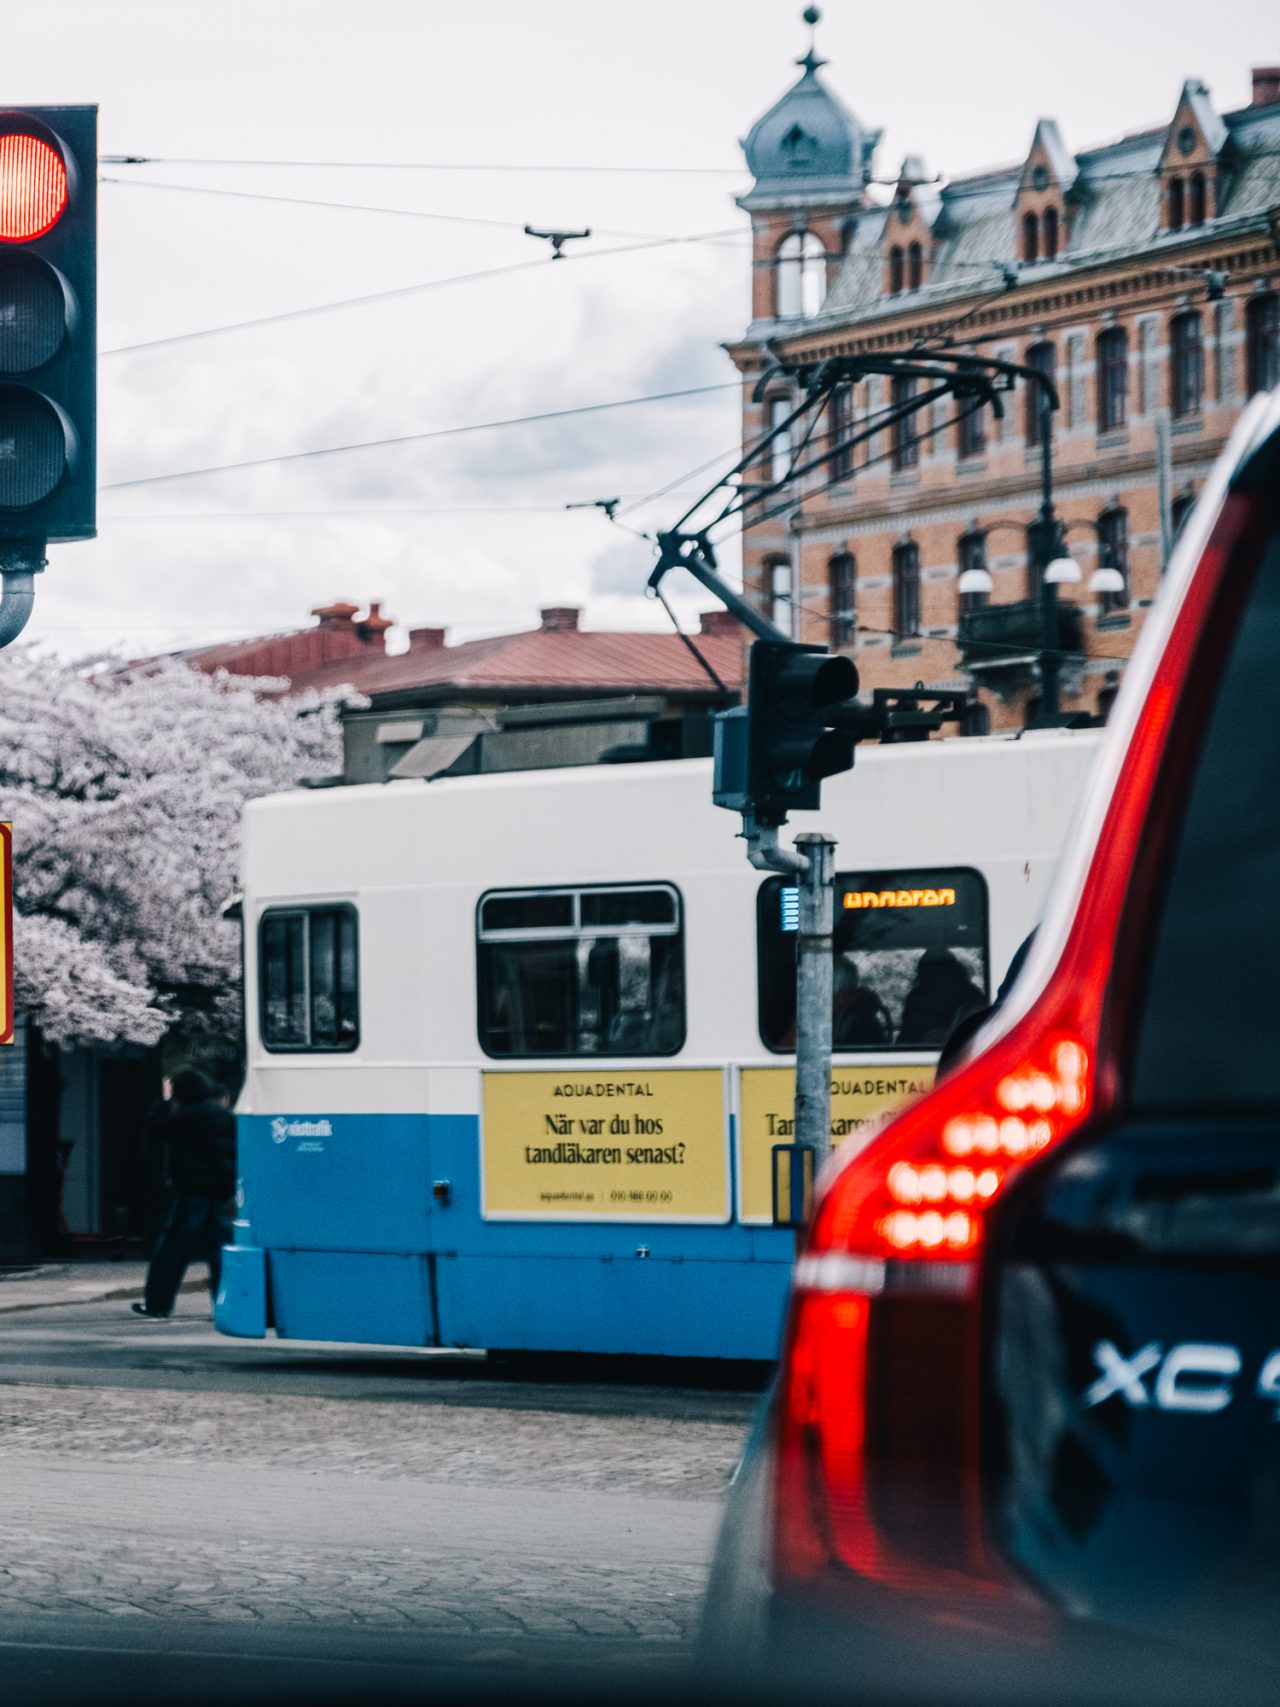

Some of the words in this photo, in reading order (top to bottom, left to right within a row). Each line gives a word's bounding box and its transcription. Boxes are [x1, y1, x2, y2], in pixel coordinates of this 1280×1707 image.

[544, 1113, 575, 1135] När
[579, 1118, 606, 1135] var
[609, 1113, 631, 1135] du
[633, 1113, 664, 1135] hos
[525, 1142, 622, 1165] tandläkaren
[626, 1141, 687, 1165] senast?
[1083, 1337, 1243, 1413] XC
